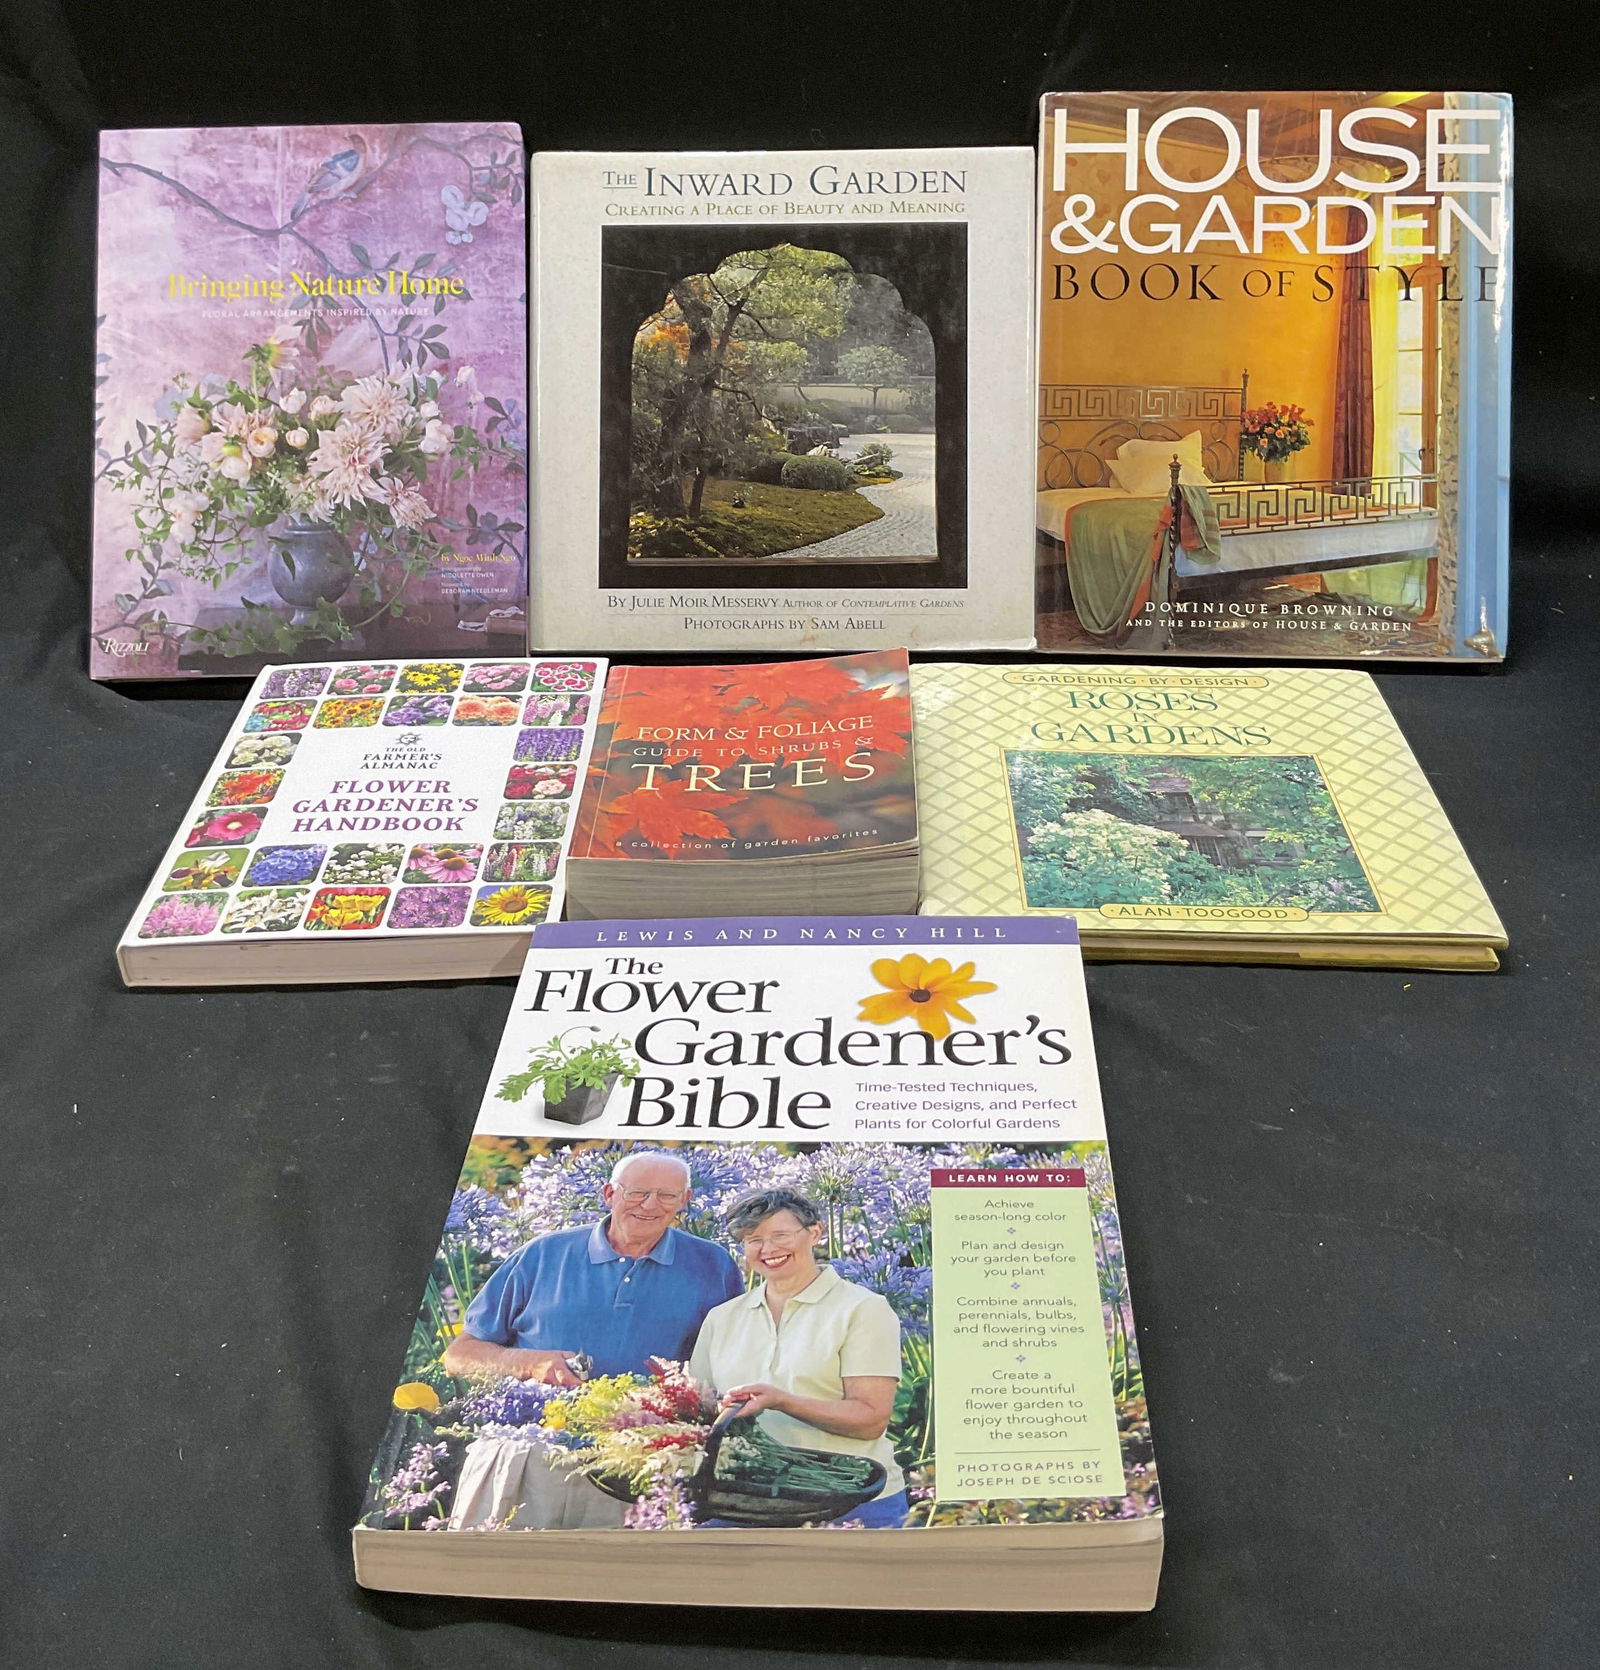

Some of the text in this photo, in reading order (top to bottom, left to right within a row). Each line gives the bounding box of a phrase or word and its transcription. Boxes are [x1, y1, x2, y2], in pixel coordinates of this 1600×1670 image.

[1052, 106, 1501, 193] HOUSE
[603, 165, 968, 197] THE INWARD GARDEN
[605, 201, 965, 216] CREATING A PLACE OF BEAUTY AND MEANING
[168, 270, 464, 303] Bringing Nature Home
[1053, 263, 1501, 302] BOOK OF STYLE
[203, 310, 240, 318] FLORAL
[244, 309, 323, 317] ARRANGEMENTS
[327, 308, 371, 316] INSPIRED
[608, 595, 964, 611] BY JULIE MOIR MESSERVY AUTHOR OF CONTEMPLATIVE GARDENS
[1145, 602, 1394, 618] DOMINIQUE BROWNING
[684, 617, 886, 631] PHOTOGRAPHS BY SAM ABELL
[1159, 619, 1184, 628] THE
[1190, 620, 1246, 628] EDITORS
[1276, 620, 1327, 630] HOUSE
[1333, 622, 1342, 630] &
[1350, 622, 1412, 632] GARDEN
[1022, 675, 1137, 685] GARDENING
[1180, 678, 1249, 686] DESIGN
[1064, 690, 1219, 712] ROSES
[1132, 712, 1158, 723] IN
[638, 715, 874, 742] FORM & FOLIAGE
[1031, 721, 1272, 746] GARDENS
[633, 736, 874, 758] GUIDE TO SHRUBS &
[363, 753, 442, 761] FARMER'S
[360, 762, 438, 770] ALMANAC
[632, 752, 876, 792] TREES
[330, 780, 452, 794] FLOWER
[292, 798, 479, 813] GARDENER'S
[291, 817, 465, 832] HANDBOOK
[616, 828, 878, 850] a collection of garden favorites
[1119, 906, 1288, 919] ALAN TOOGOOD
[596, 927, 1008, 943] LEWIS AND NANCY HILL
[605, 957, 663, 975] The
[524, 967, 780, 1013] Flower
[856, 1081, 1038, 1096] Time-Tested Techniques,
[618, 1076, 832, 1129] Bible
[855, 1098, 1078, 1114] Creative Designs, and Perfect
[855, 1117, 1061, 1129] Plants for Colorful Gardens
[1046, 1174, 1071, 1182] TO:
[985, 1200, 1034, 1208] Achieve
[954, 1212, 1067, 1223] season-long color
[961, 1241, 1064, 1251] Plan and design
[951, 1254, 1076, 1264] your garden before
[984, 1268, 1045, 1278] you plant
[957, 1297, 1077, 1307] Combine annuals,
[958, 1310, 1077, 1321] perennials, bulbs,
[953, 1324, 1085, 1335] and flowering vines
[982, 1338, 1058, 1348] and shrubs
[992, 1370, 1039, 1379] Create
[972, 1384, 1075, 1394] more bountiful
[965, 1399, 1083, 1411] flower garden to
[963, 1414, 1087, 1427] enjoy throughout
[990, 1430, 1068, 1439] the season
[957, 1461, 1101, 1472] PHOTOGRAPHS BY
[957, 1475, 1103, 1487] JOSEPH DE SCIOSE
